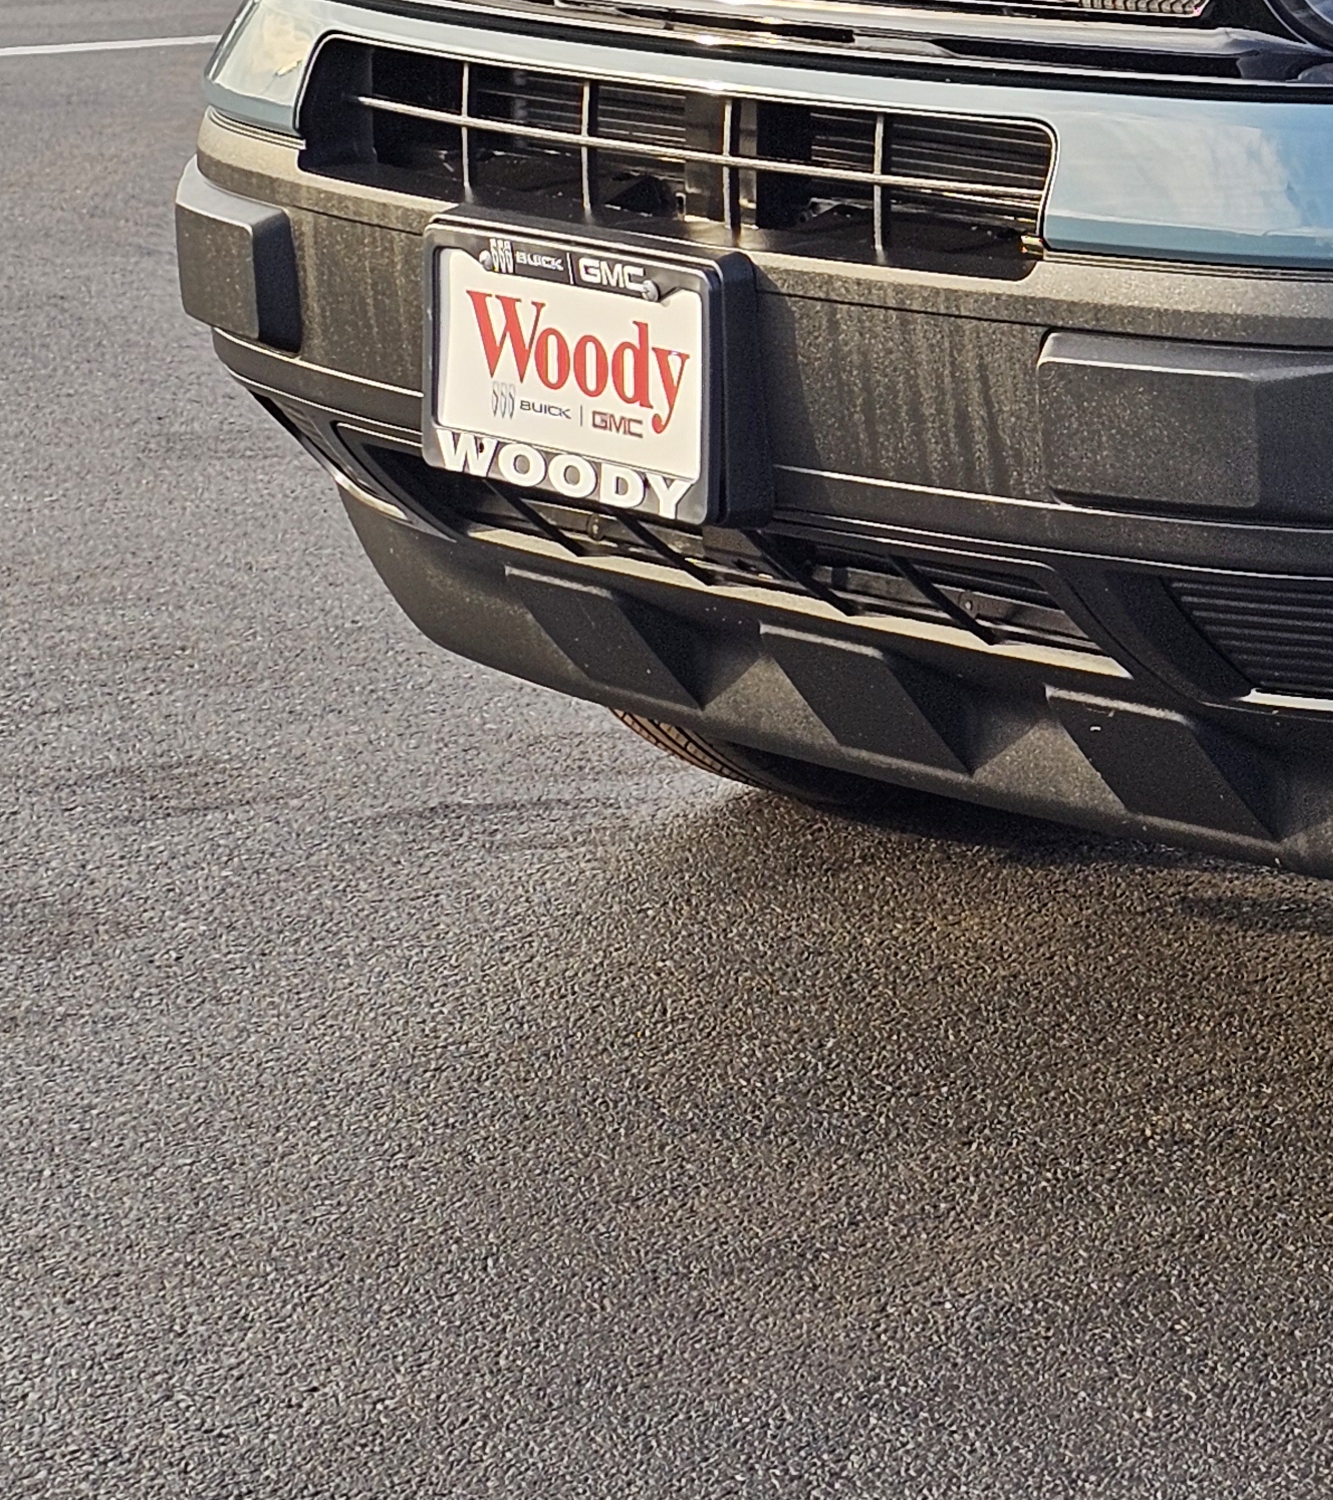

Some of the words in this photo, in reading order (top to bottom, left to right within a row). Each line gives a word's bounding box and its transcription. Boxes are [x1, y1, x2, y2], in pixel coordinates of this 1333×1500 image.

[515, 250, 564, 271] BUICK
[578, 256, 647, 292] GMC
[465, 289, 690, 433] Woody
[519, 400, 572, 419] BUICK
[591, 410, 644, 438] GMC
[437, 428, 695, 520] WOODY
